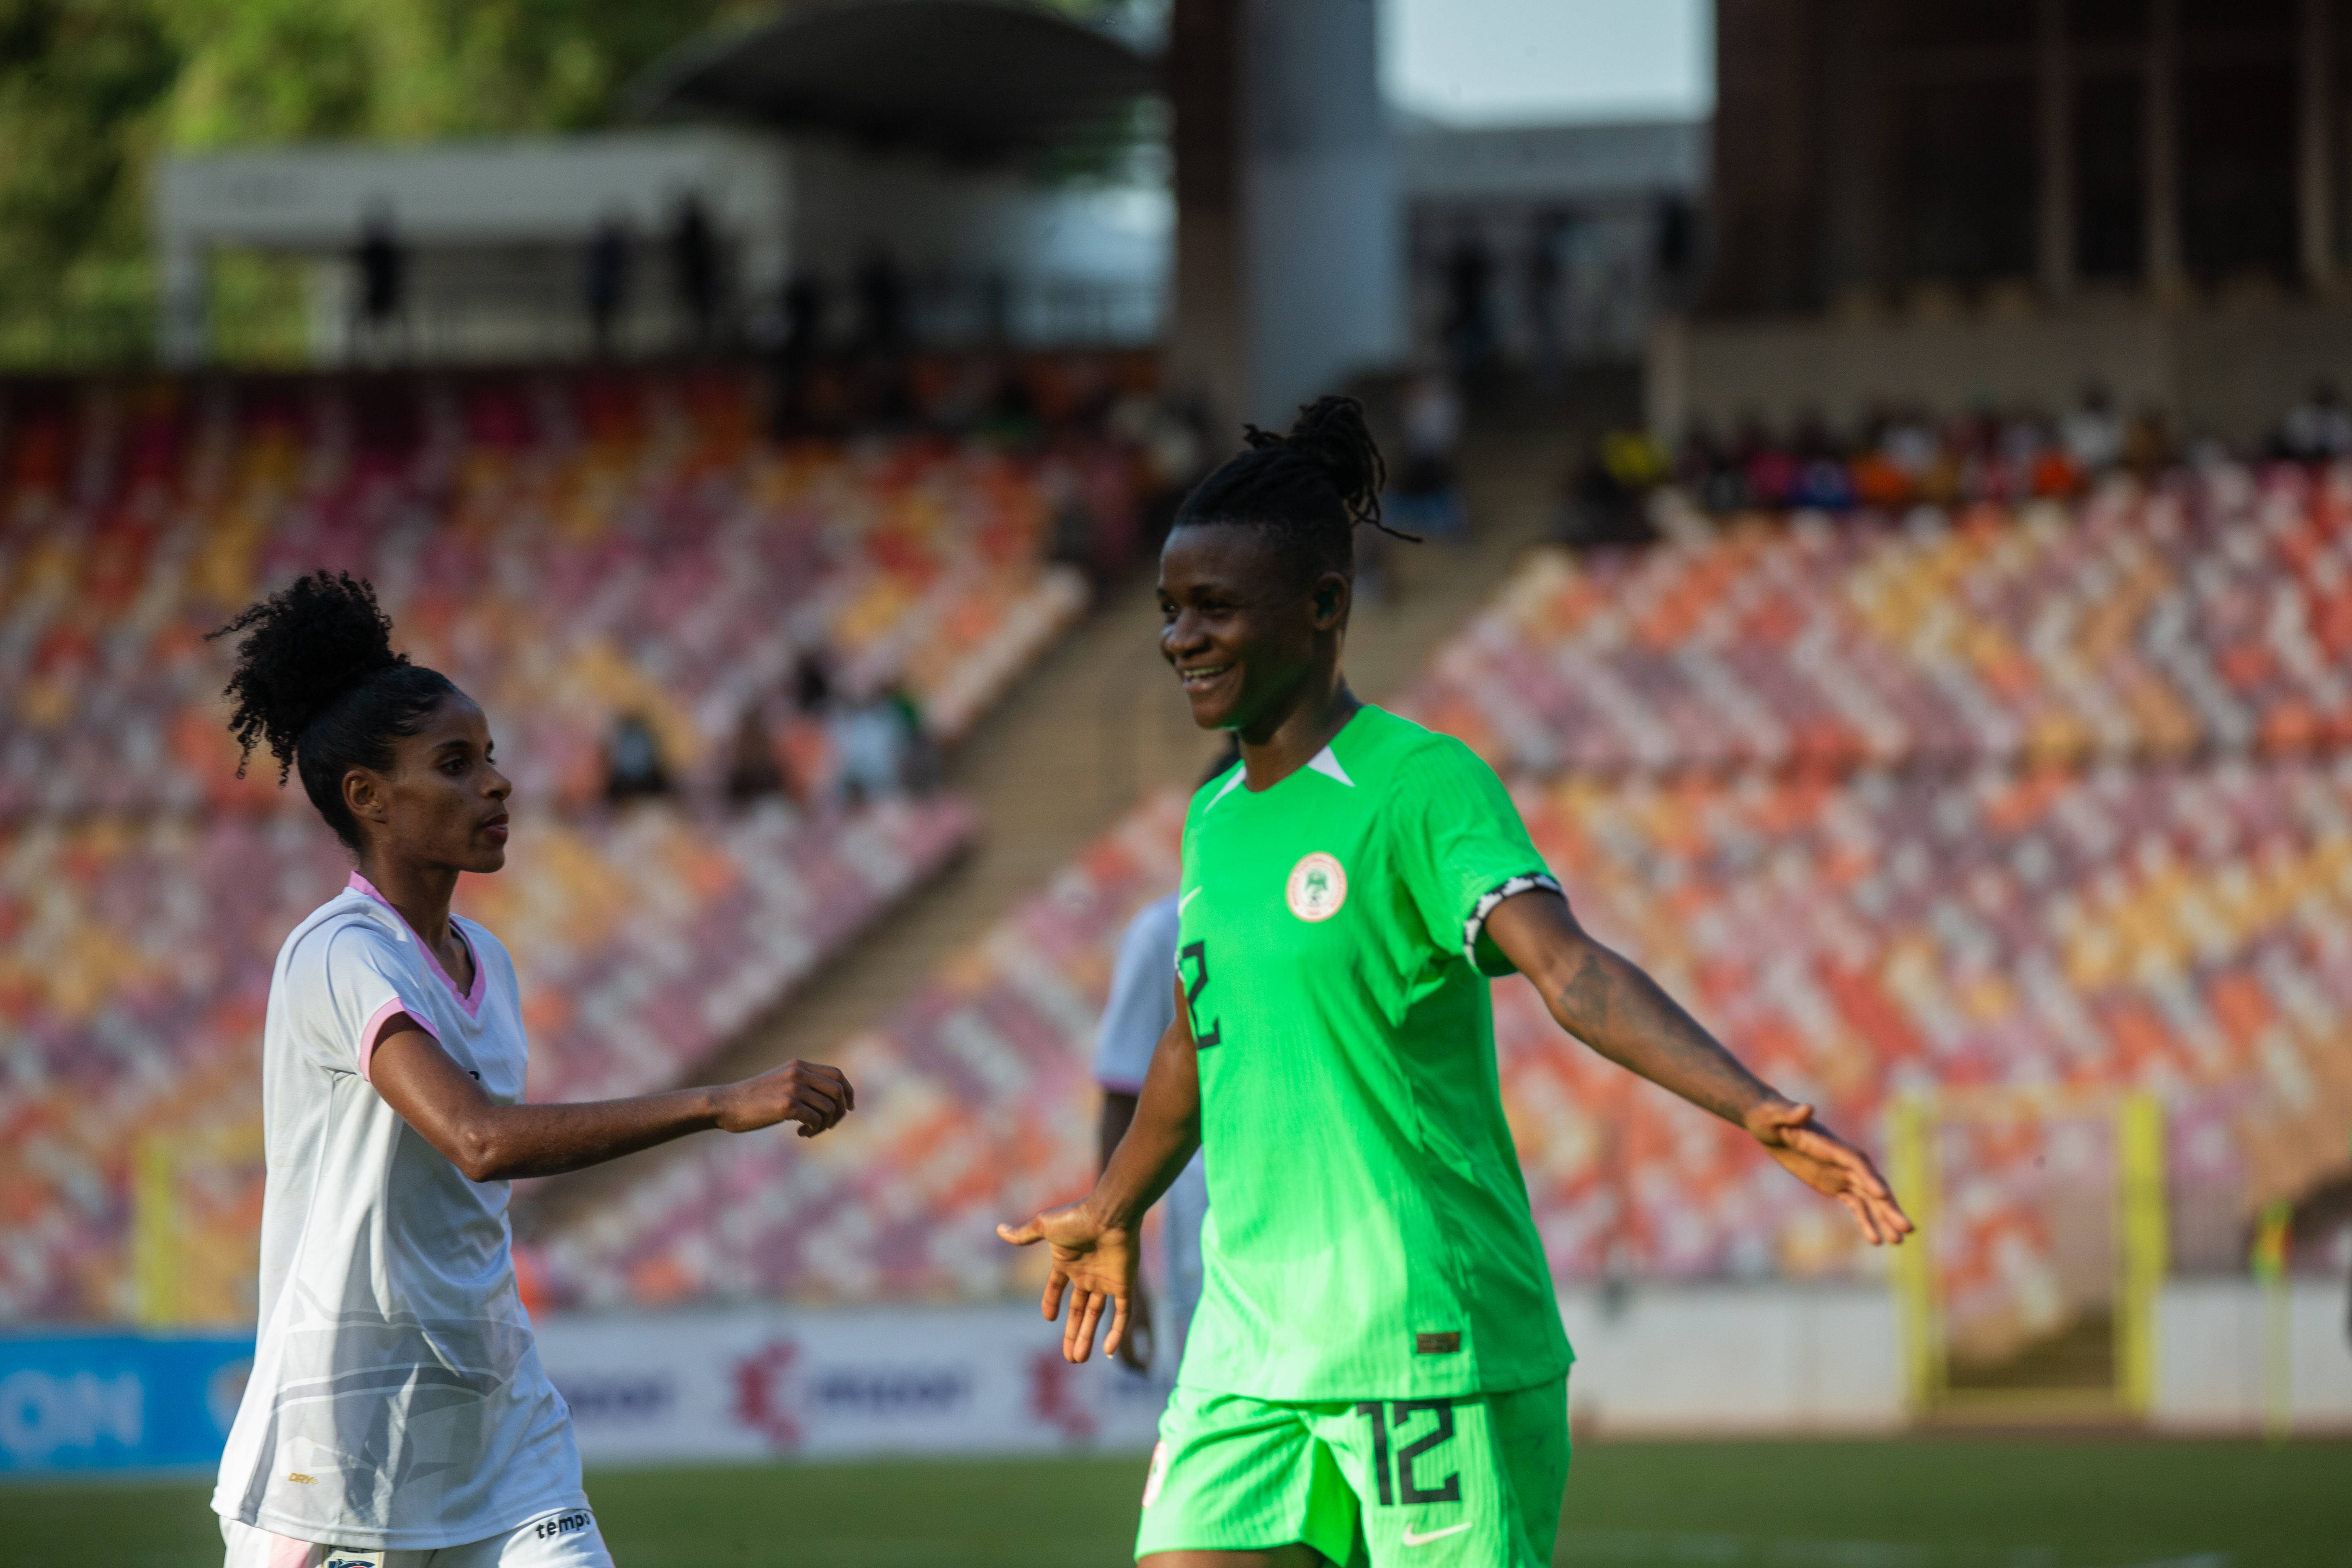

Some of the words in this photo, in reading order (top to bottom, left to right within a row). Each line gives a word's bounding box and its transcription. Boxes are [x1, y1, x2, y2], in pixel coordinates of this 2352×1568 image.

[1181, 940, 1220, 1050] 2
[1356, 1399, 1460, 1505] 12
[536, 1513, 590, 1539] tempo
